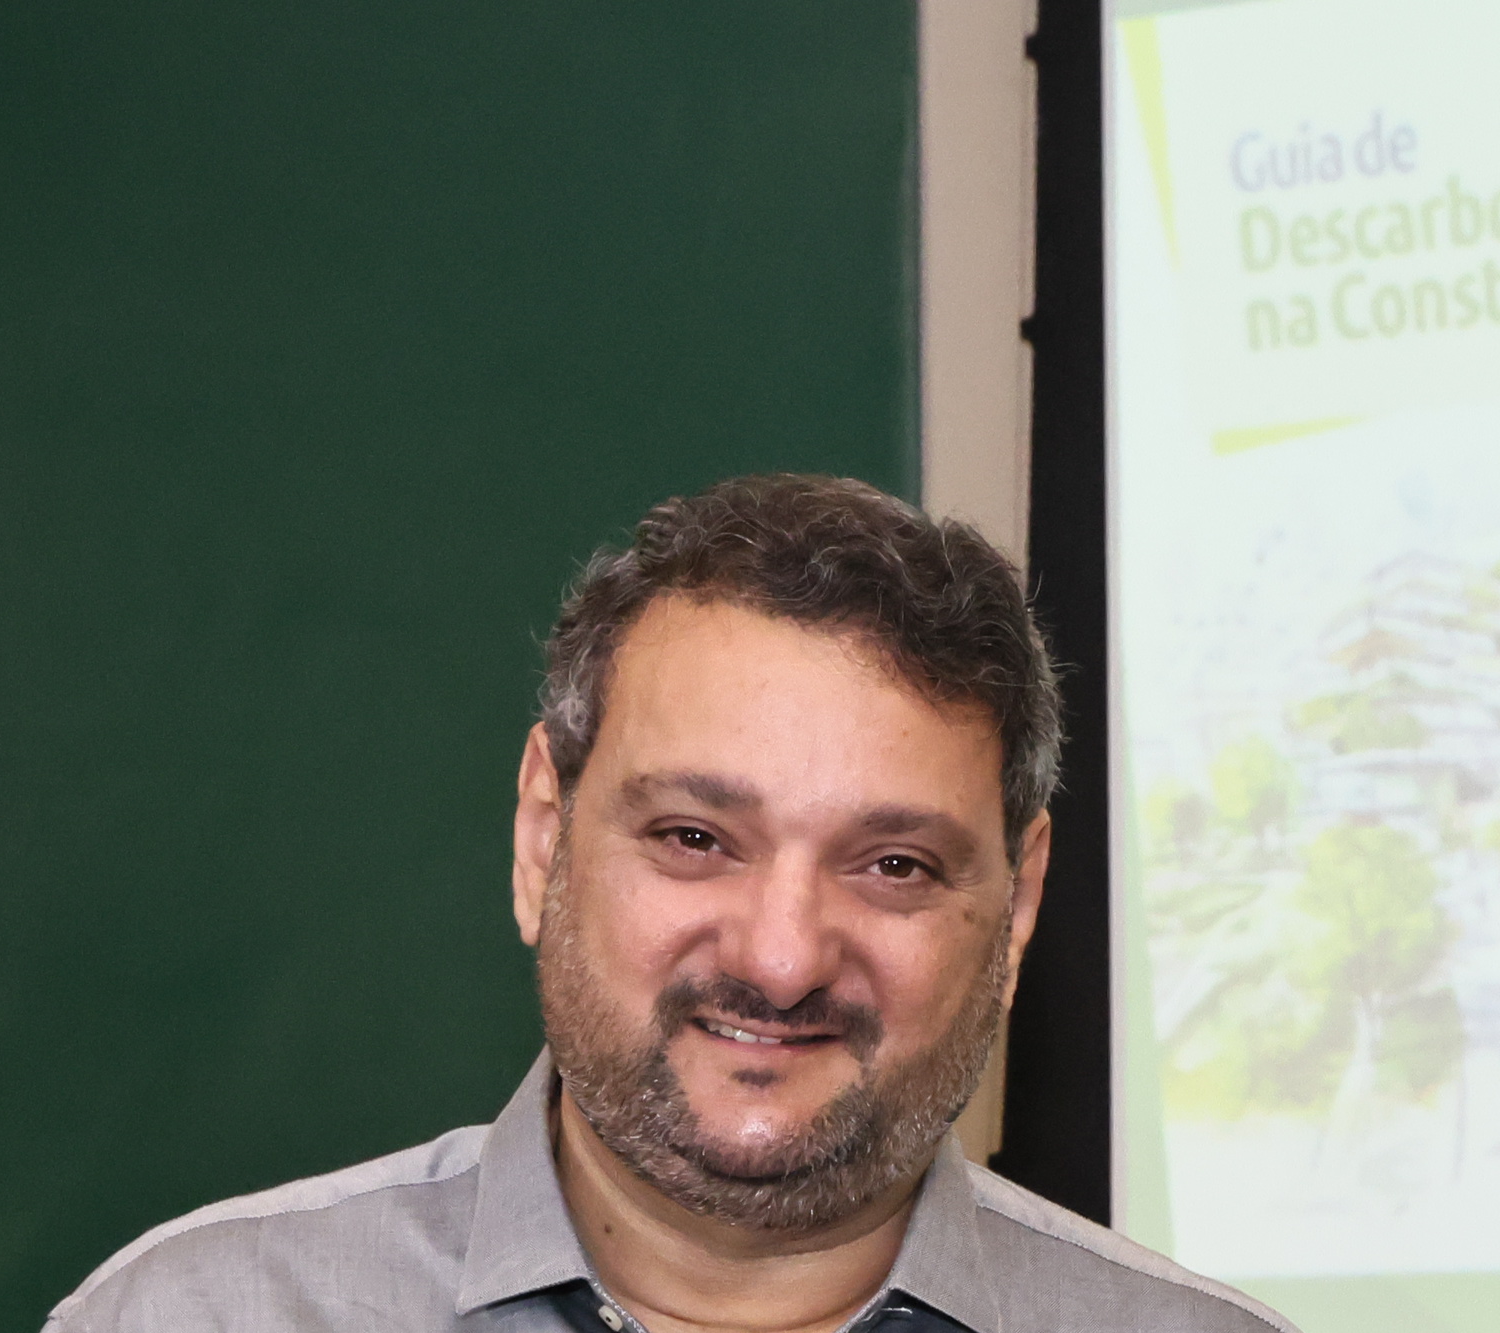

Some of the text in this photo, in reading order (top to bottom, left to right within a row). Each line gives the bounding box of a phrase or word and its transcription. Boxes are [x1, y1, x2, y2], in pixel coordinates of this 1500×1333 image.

[1228, 112, 1419, 196] Guia de
[1244, 290, 1318, 352] na
